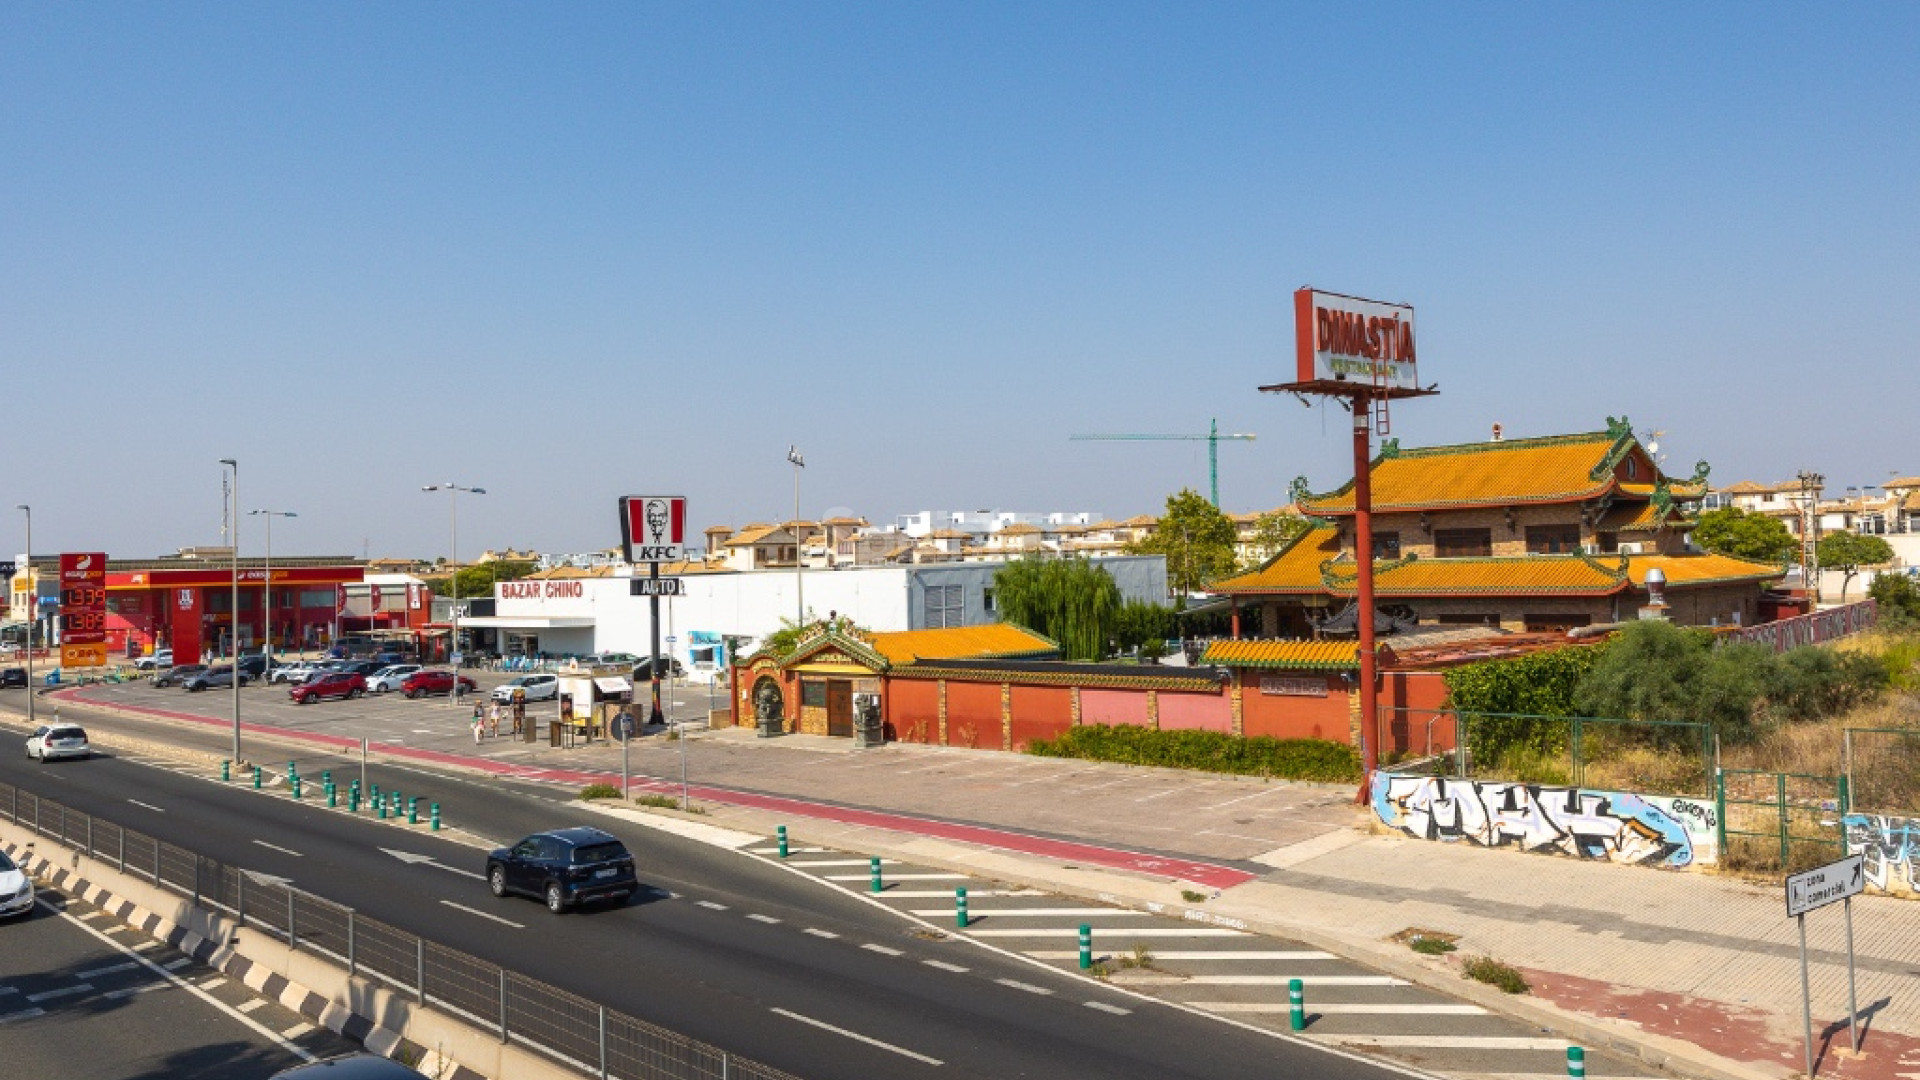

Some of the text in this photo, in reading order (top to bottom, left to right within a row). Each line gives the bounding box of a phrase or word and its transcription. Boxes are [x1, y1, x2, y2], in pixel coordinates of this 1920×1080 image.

[1316, 306, 1415, 363] DINASTÍA
[640, 546, 676, 560] KFC
[502, 581, 583, 599] BAZAR CHINO
[642, 580, 676, 594] AUTO
[1807, 873, 1825, 887] zona
[1807, 880, 1846, 903] comercial
